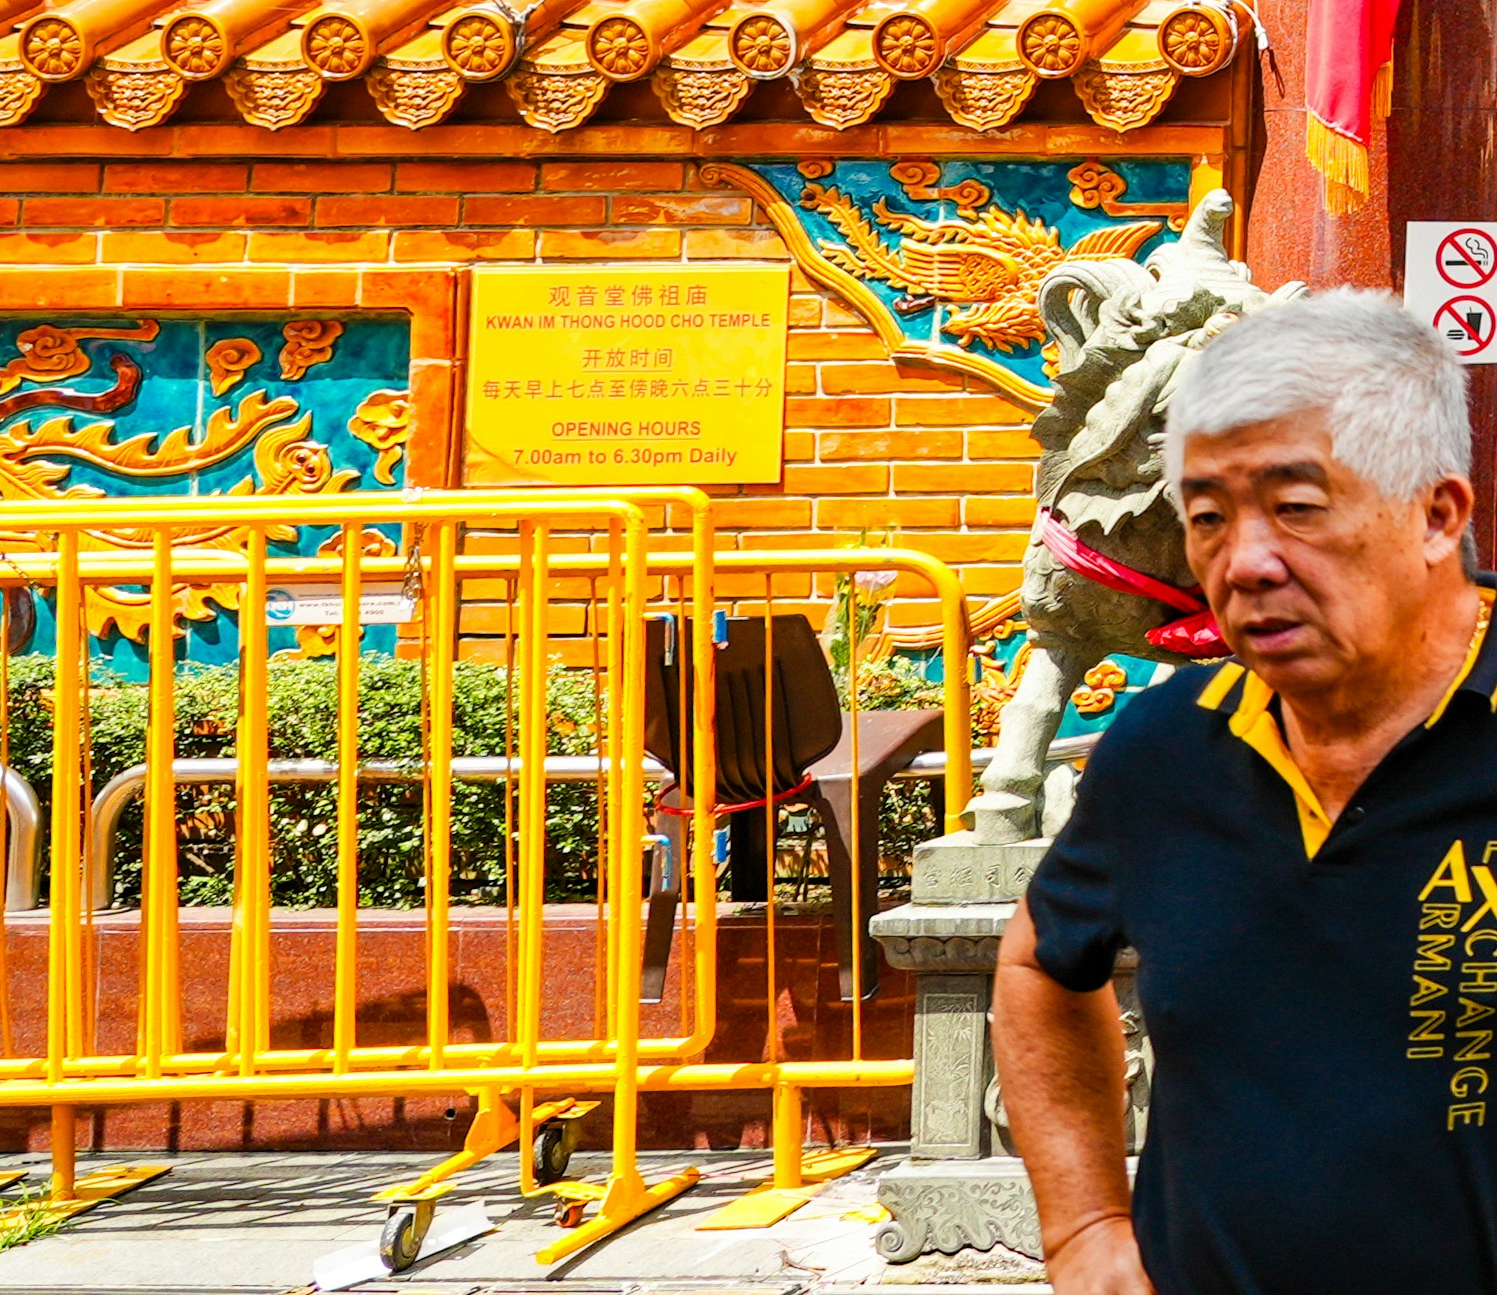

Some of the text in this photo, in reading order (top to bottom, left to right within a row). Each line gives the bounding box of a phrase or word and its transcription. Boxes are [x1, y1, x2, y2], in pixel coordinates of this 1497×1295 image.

[548, 284, 708, 307] 观音堂佛祖庙
[486, 313, 771, 330] KWAN IM THONG HOOD CHO TEMPLE
[582, 348, 674, 369] 开放时间
[482, 377, 773, 400] 每天早上七点至傍晚六点三十分
[551, 420, 701, 438] OPENING HOURS
[513, 447, 737, 467] 7.00am to 6.30pm Daily
